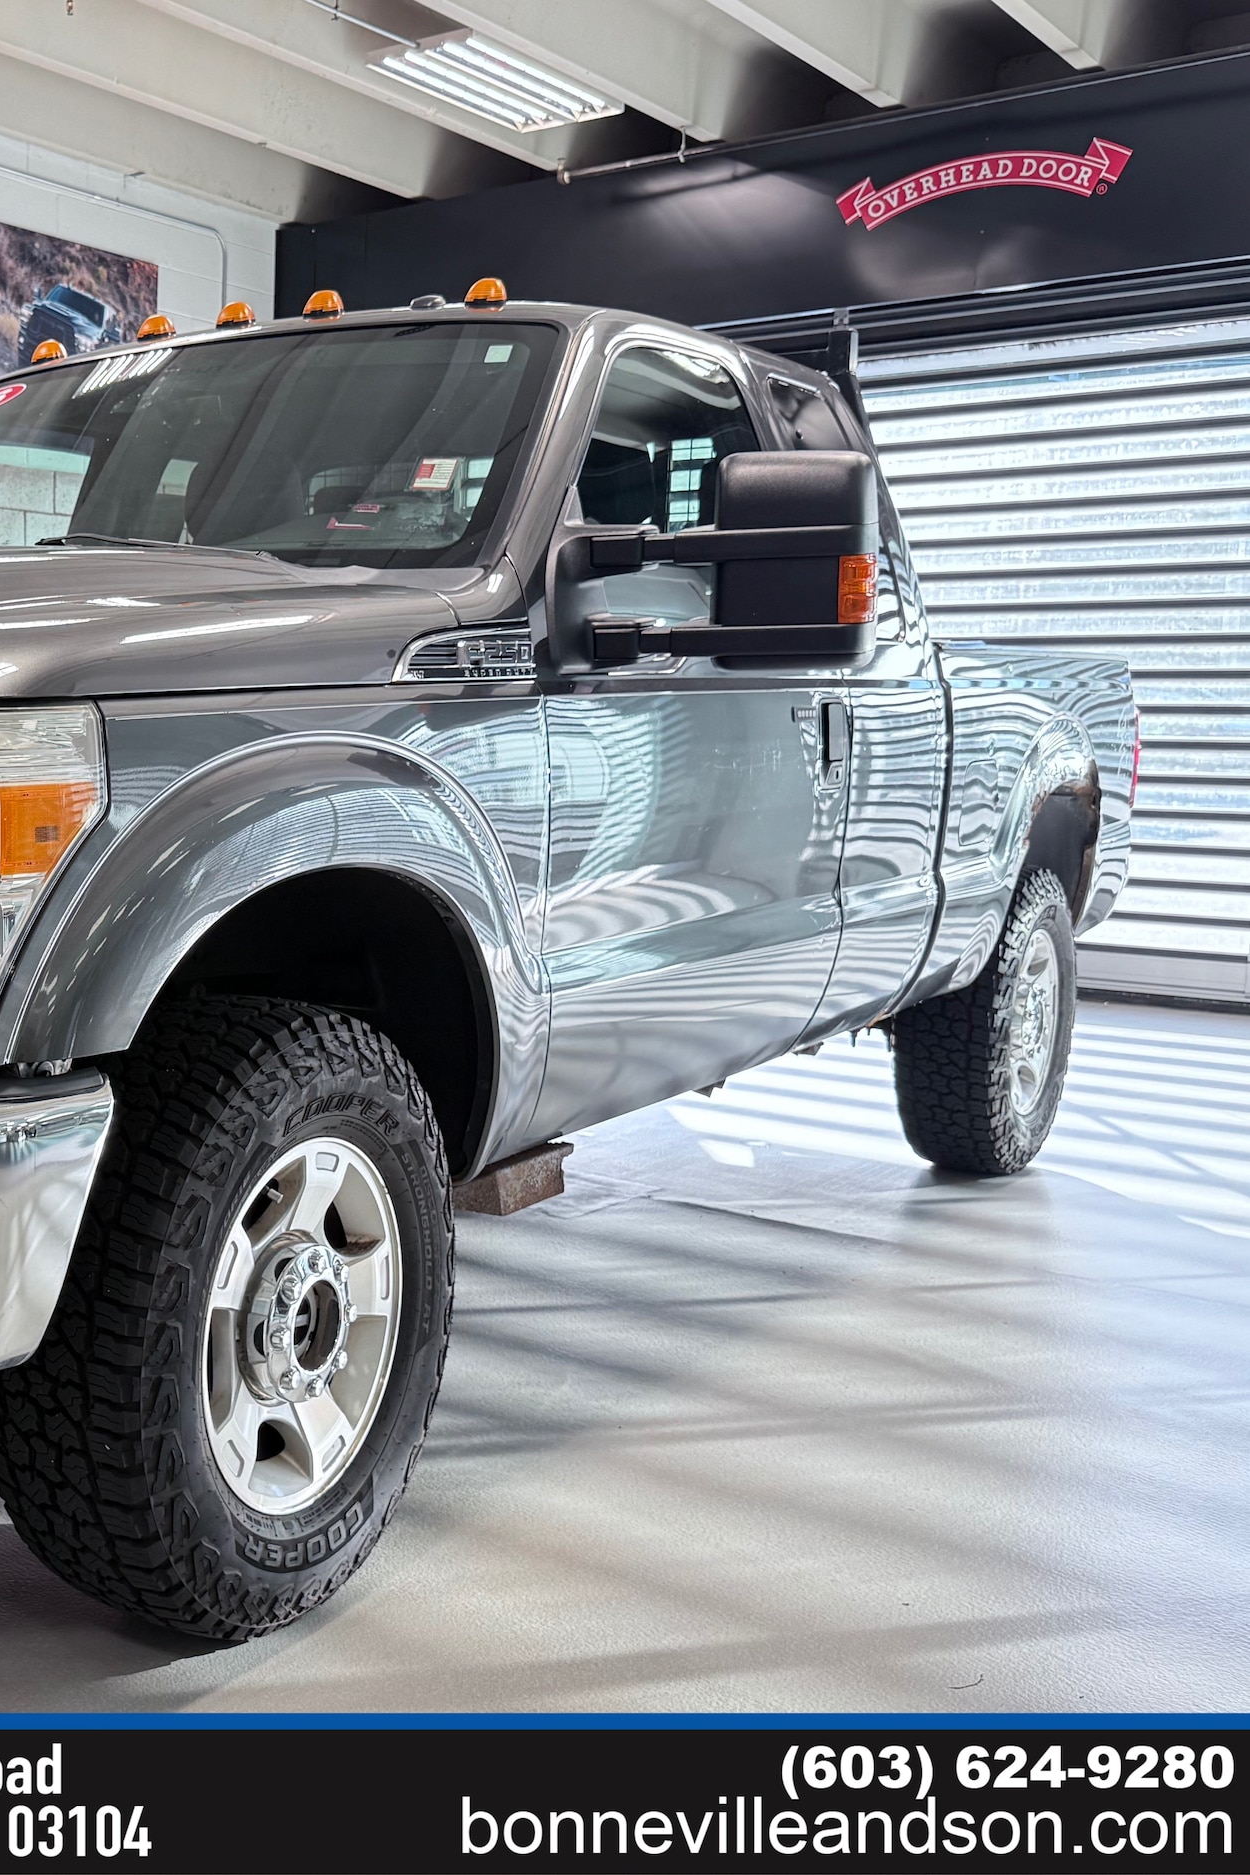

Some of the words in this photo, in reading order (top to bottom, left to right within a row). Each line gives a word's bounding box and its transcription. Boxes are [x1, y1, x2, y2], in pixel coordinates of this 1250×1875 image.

[867, 159, 1014, 218] OVERHEAD
[1019, 157, 1093, 187] DOOR
[282, 1092, 400, 1138] COOPER
[401, 1152, 433, 1290] STRONGHOLD
[243, 1501, 365, 1568] COOPER
